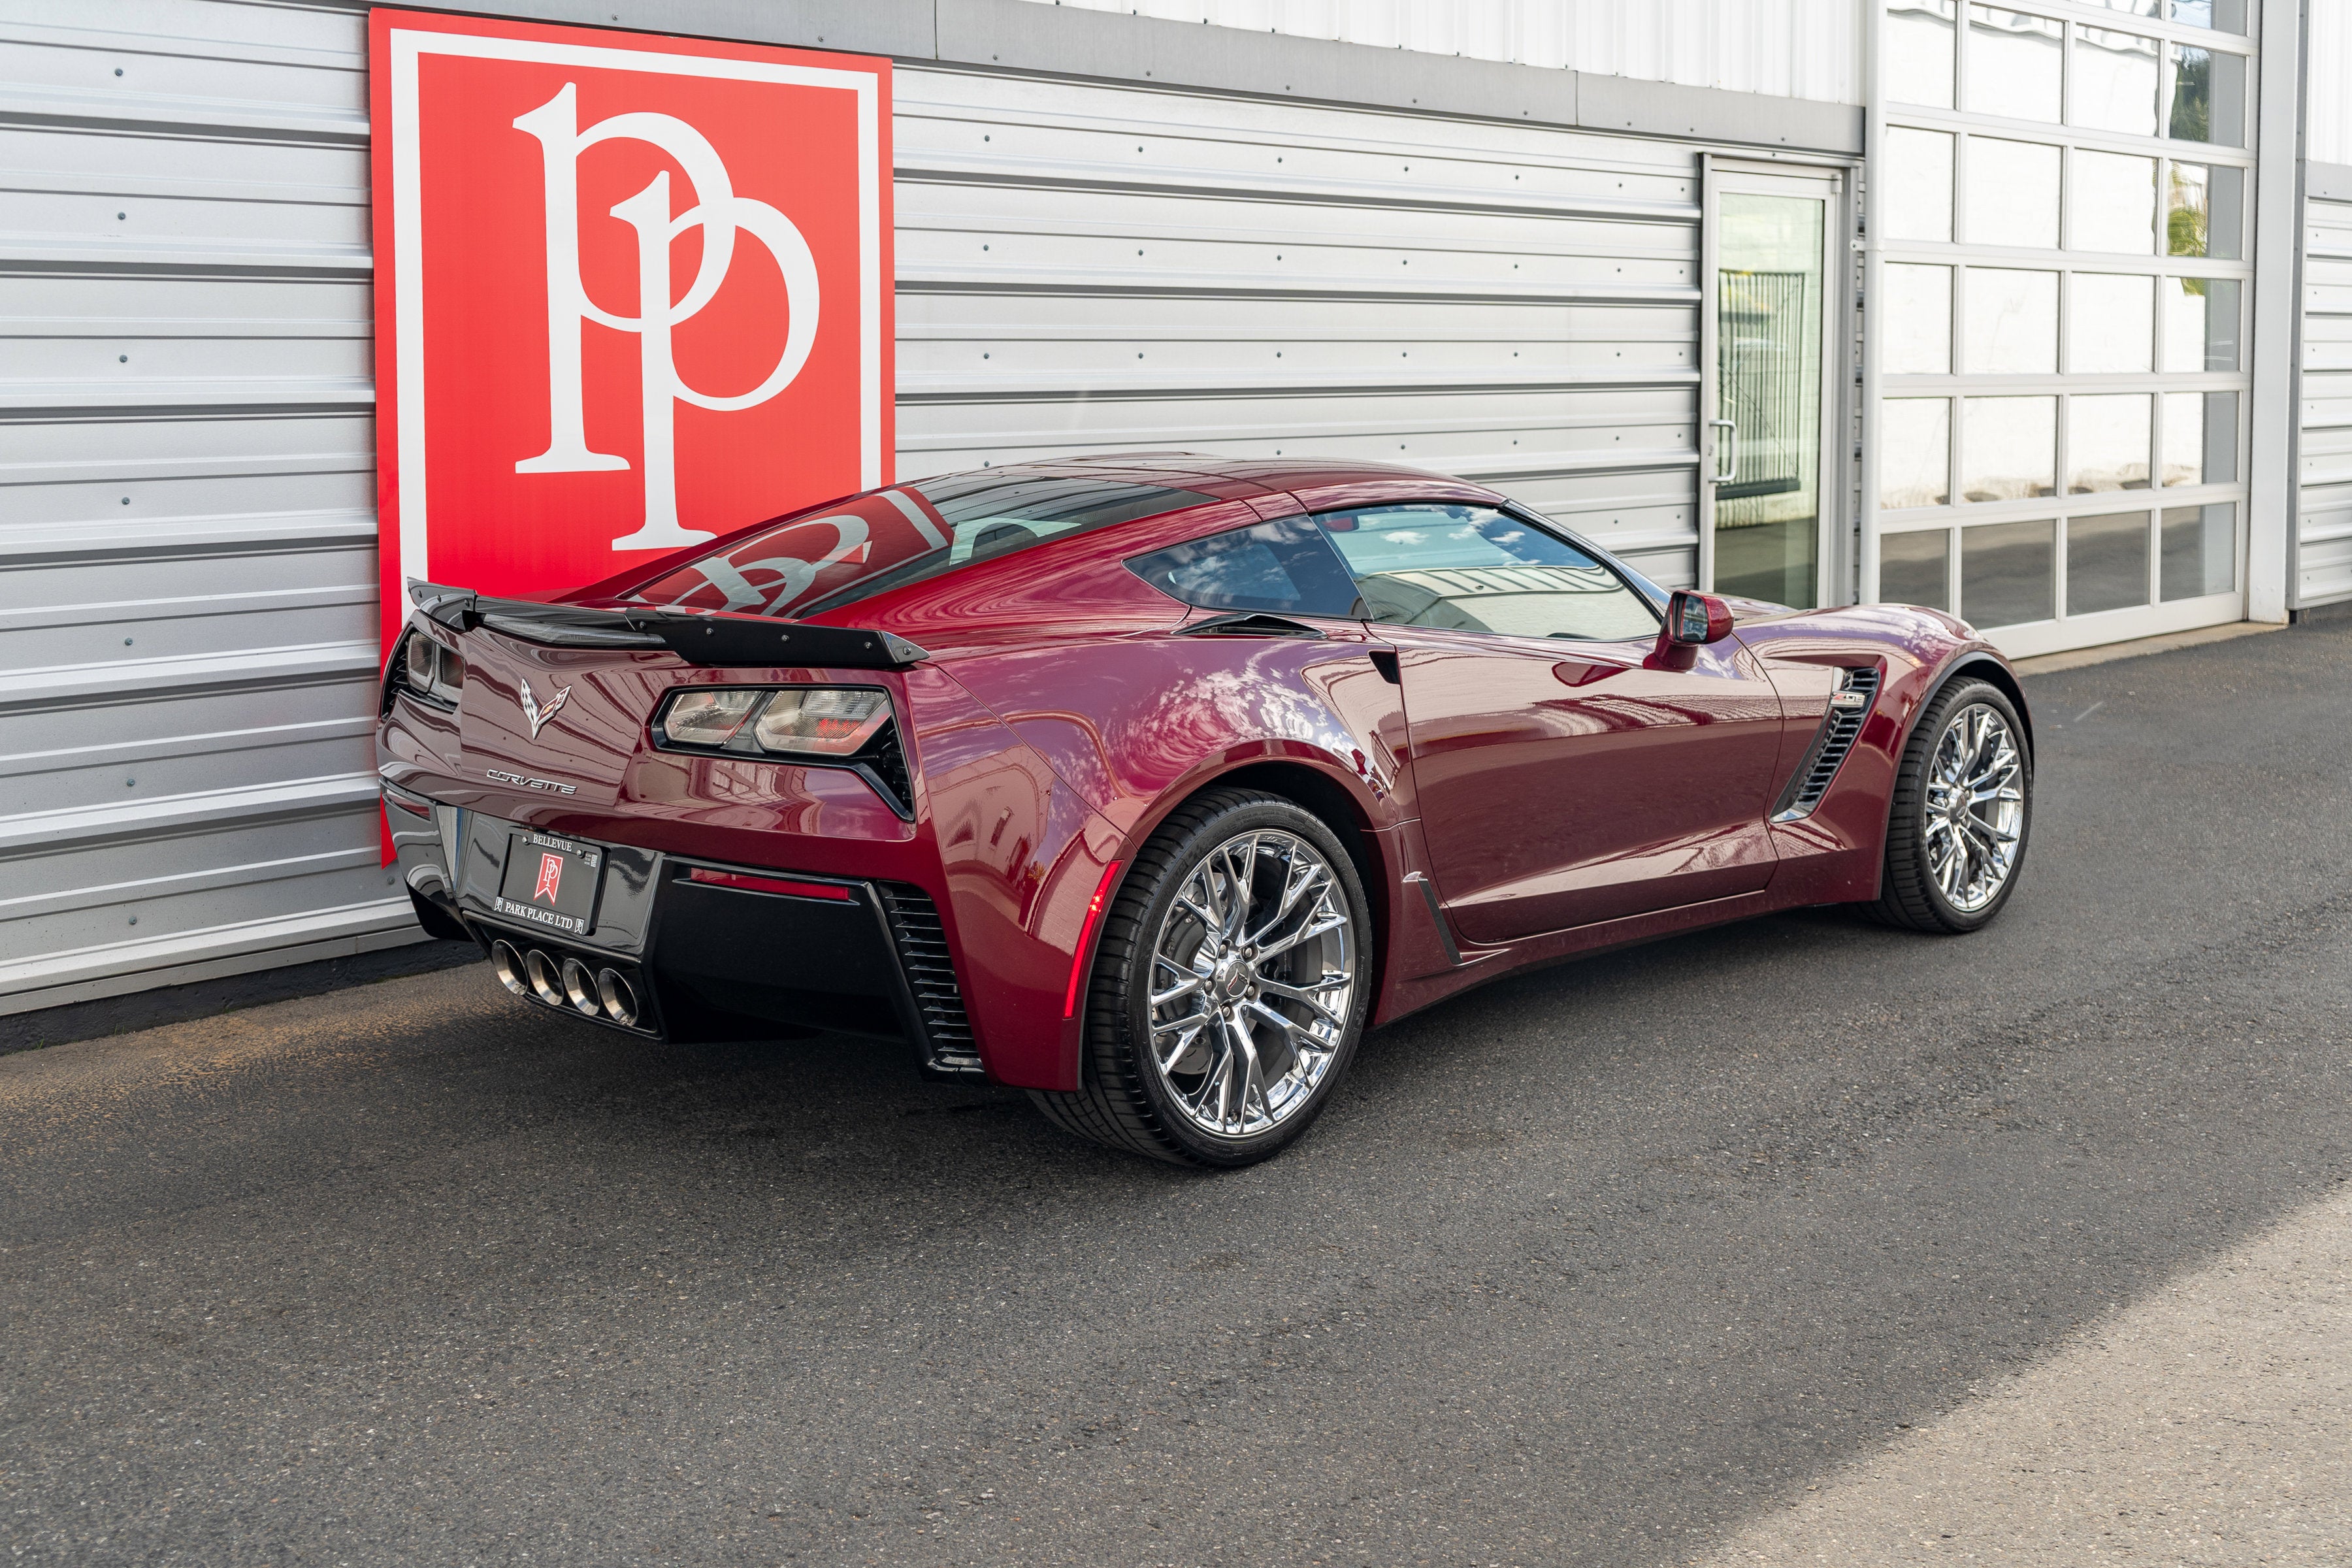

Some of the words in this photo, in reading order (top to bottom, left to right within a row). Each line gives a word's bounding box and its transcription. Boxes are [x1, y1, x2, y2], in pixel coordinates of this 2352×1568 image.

[487, 769, 577, 794] CORVETTE
[532, 834, 572, 852] BELLEVUE
[504, 902, 526, 917] PARK
[527, 907, 554, 924] PLACE
[555, 915, 573, 930] LTD
